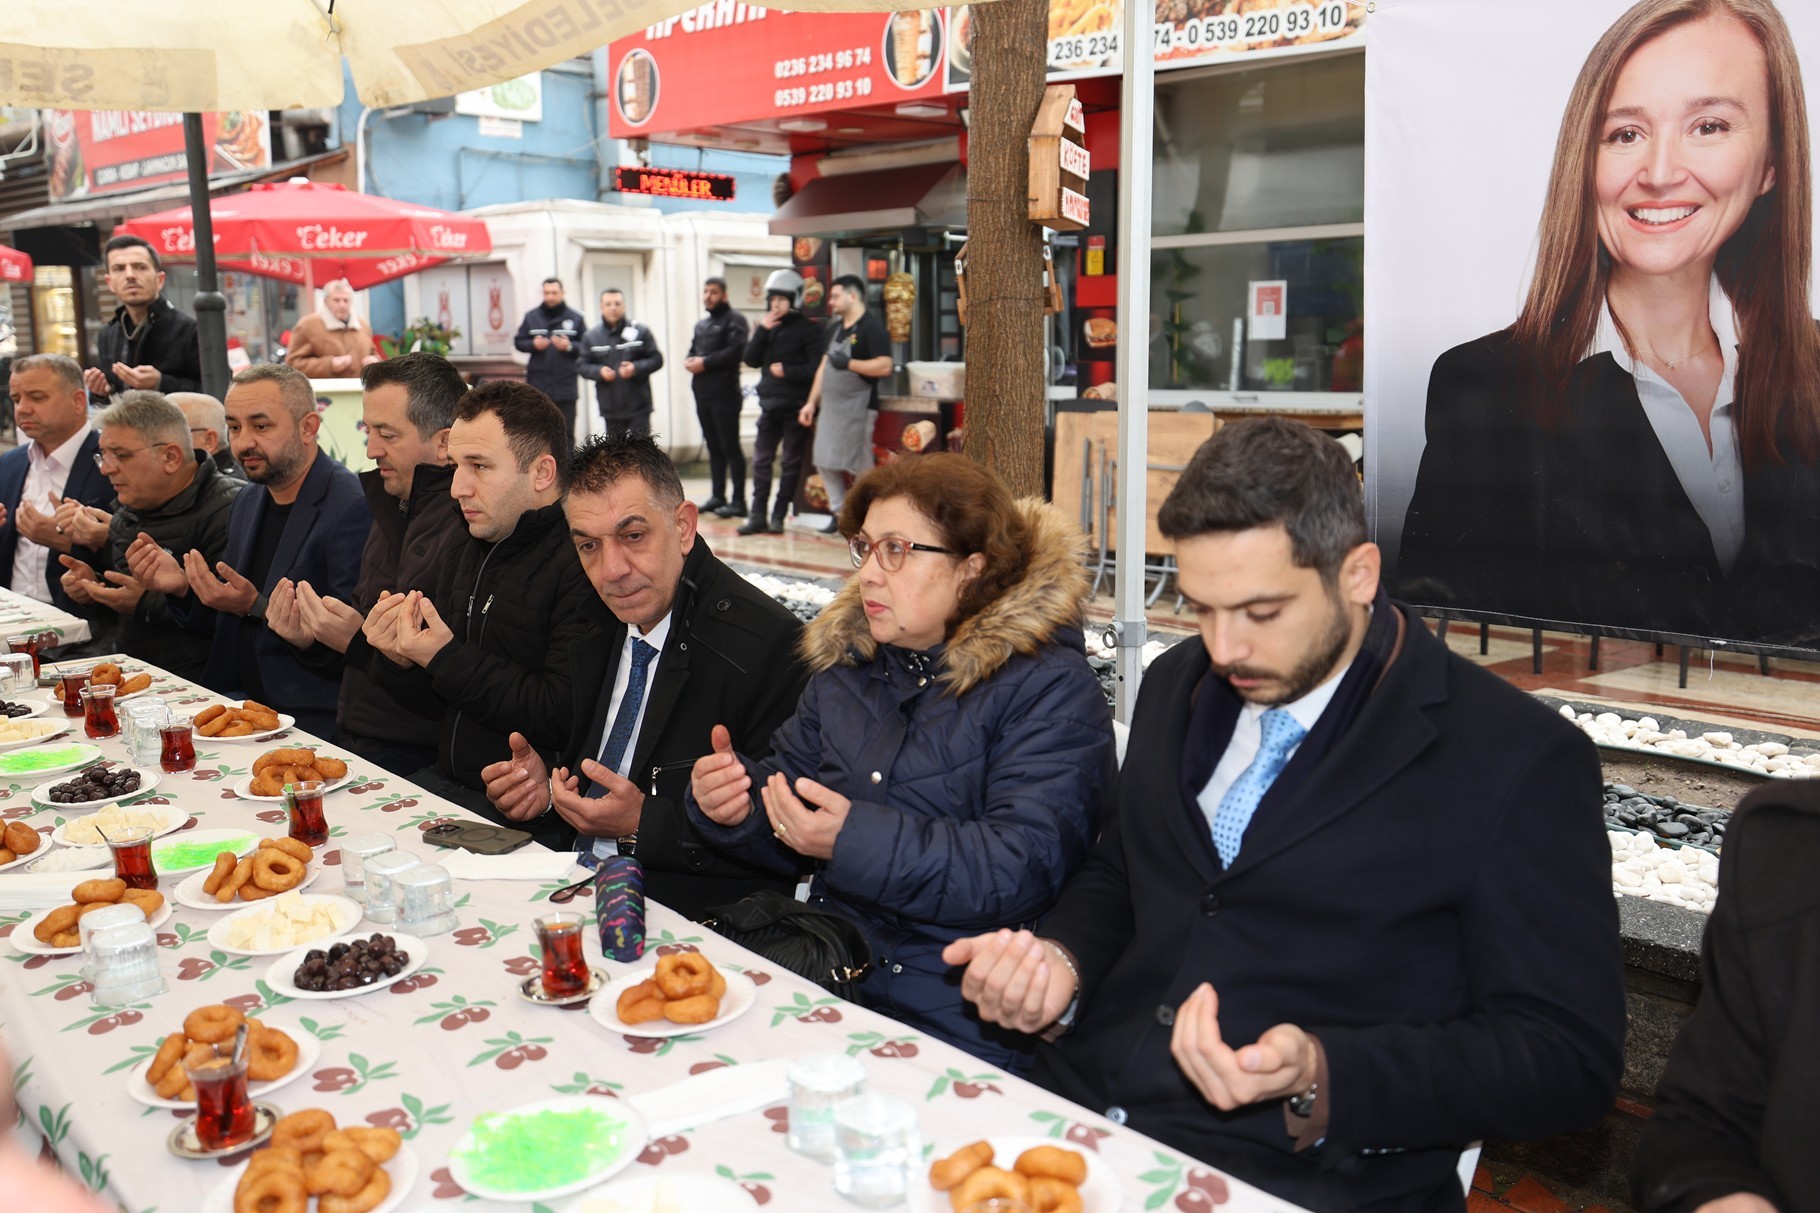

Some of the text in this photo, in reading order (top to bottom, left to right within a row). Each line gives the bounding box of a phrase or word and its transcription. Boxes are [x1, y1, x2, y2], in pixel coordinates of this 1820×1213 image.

[1055, 40, 1083, 59] 236
[1089, 36, 1118, 56] 234
[1188, 26, 1198, 44] 0
[1205, 20, 1237, 41] 539
[1245, 14, 1279, 37] 220
[1287, 11, 1310, 32] 93
[1319, 6, 1342, 27] 10
[774, 47, 871, 79] 0236 234 96 74
[774, 77, 871, 108] 0539 220 93 10
[1064, 146, 1087, 175] KÖFTE
